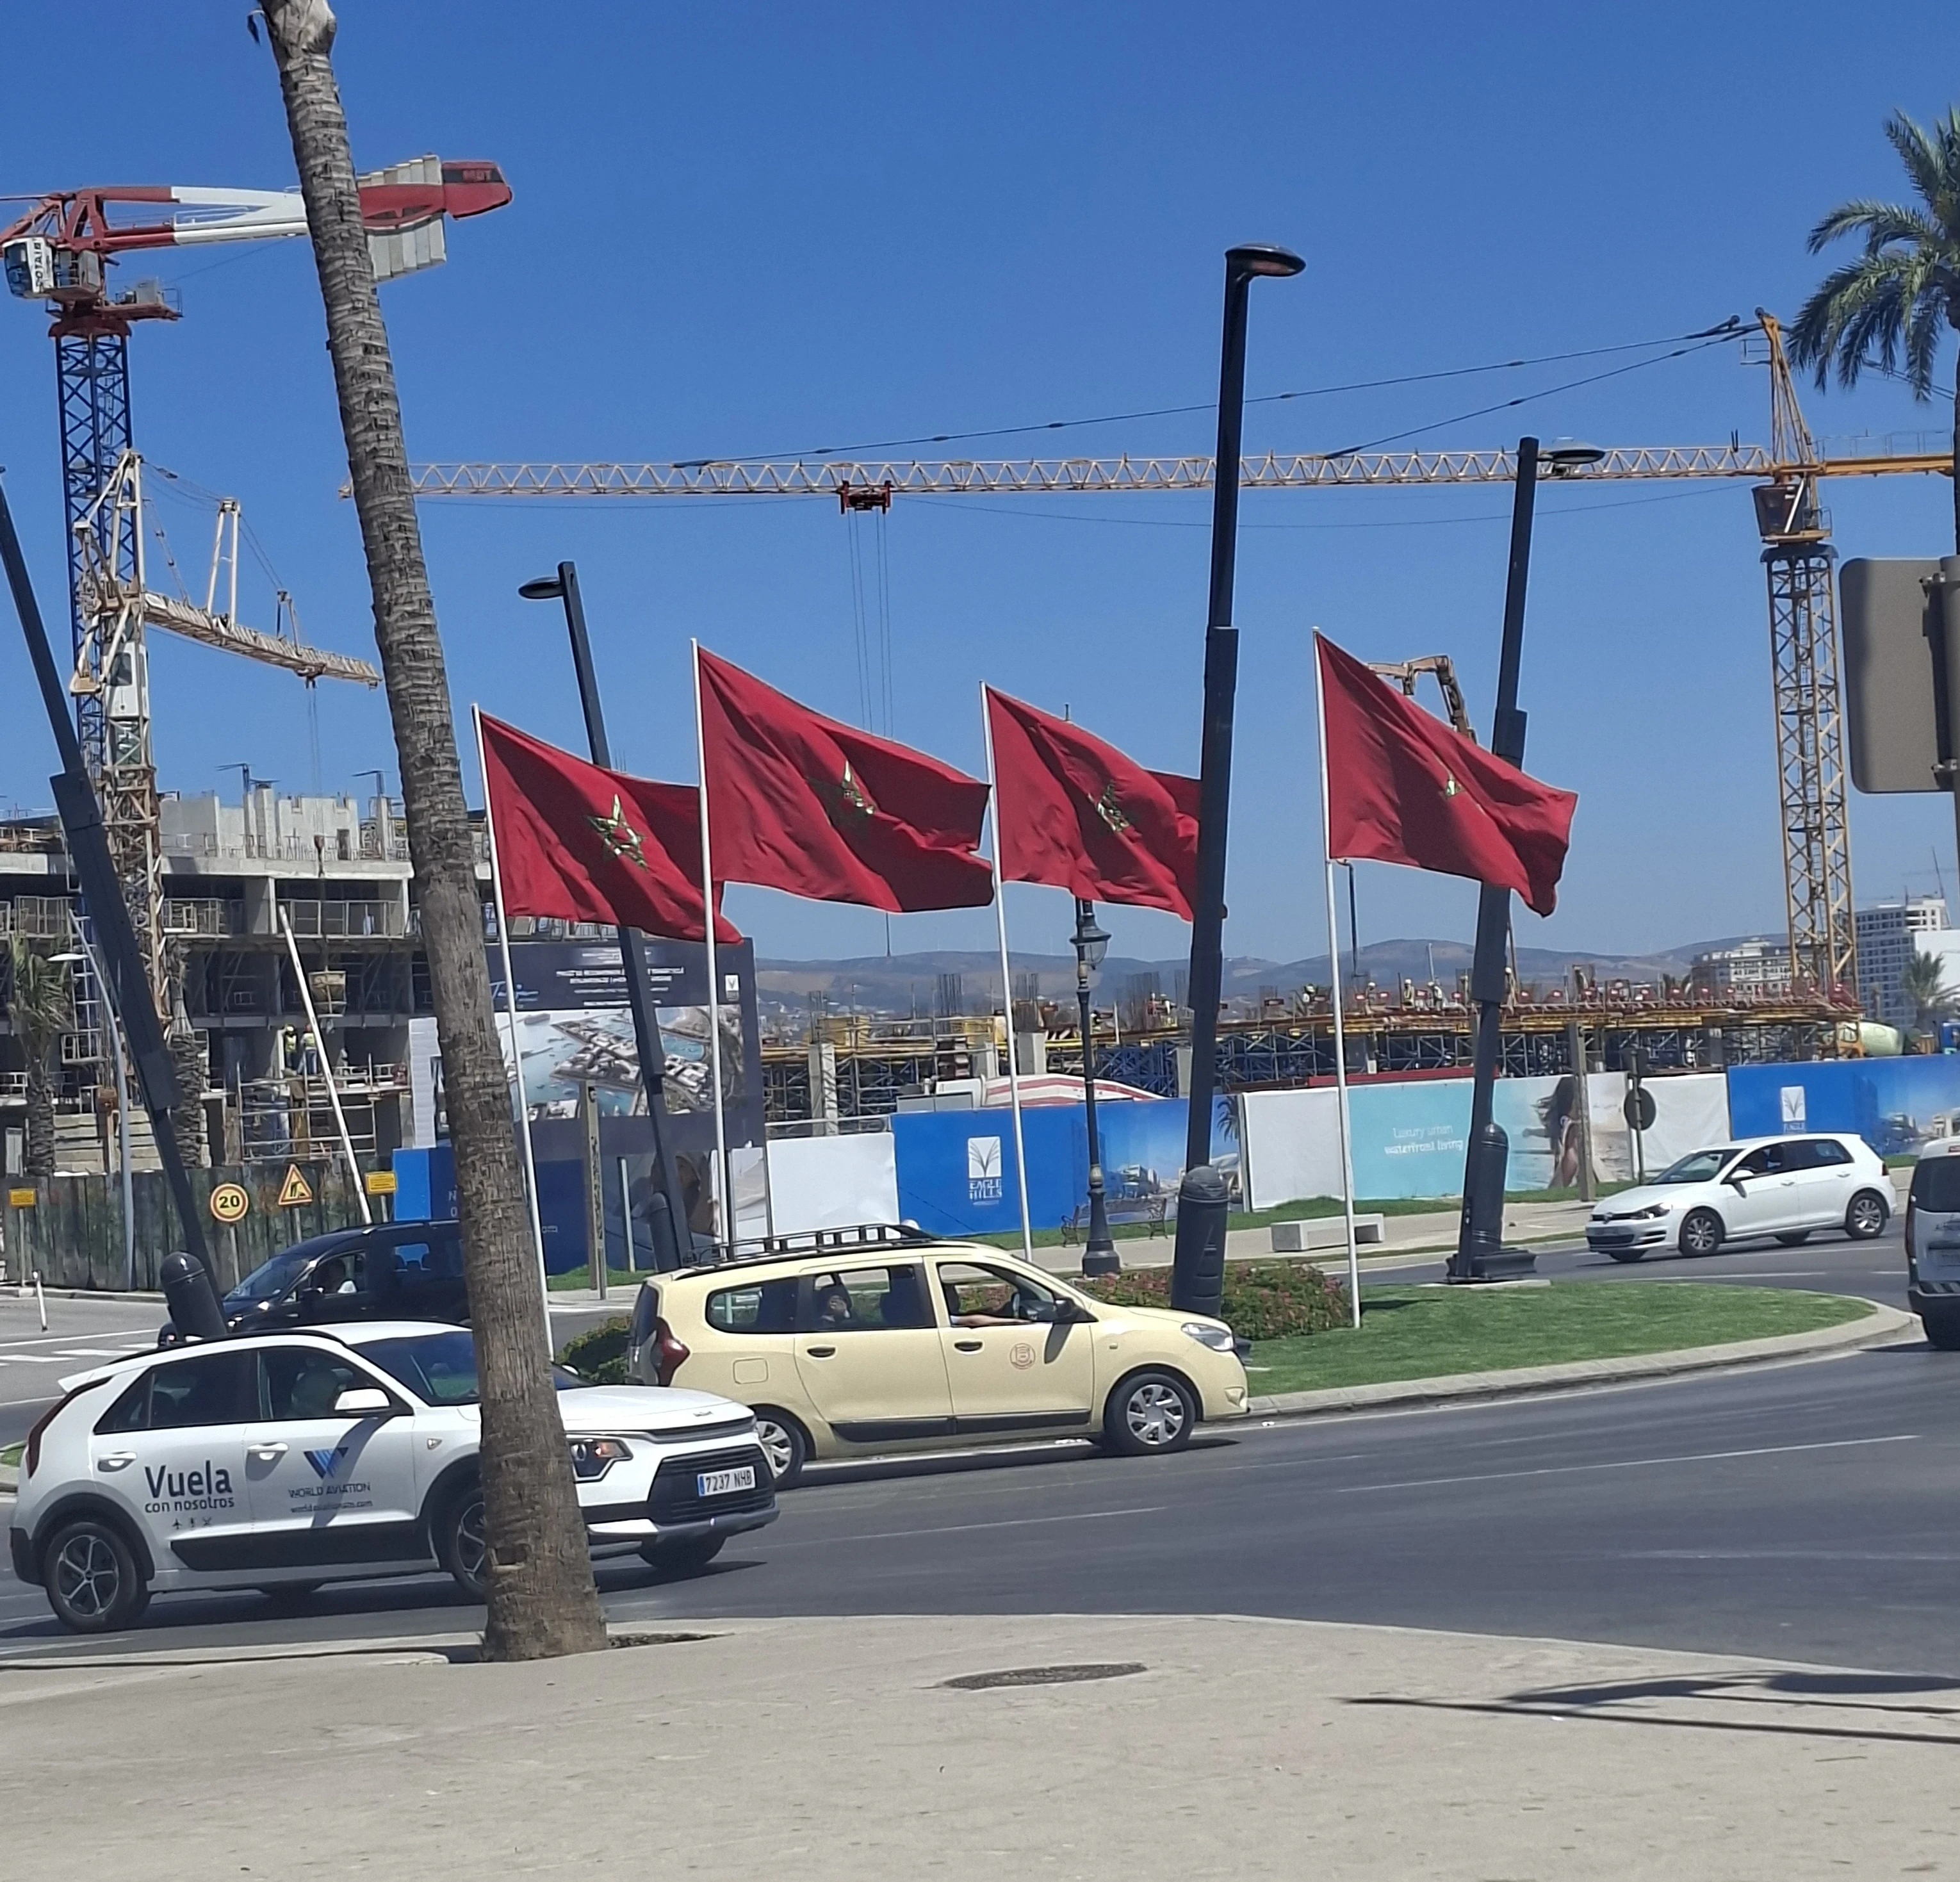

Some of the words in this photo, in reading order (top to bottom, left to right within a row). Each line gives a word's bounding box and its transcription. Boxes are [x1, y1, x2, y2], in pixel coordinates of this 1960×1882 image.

[968, 1179, 1001, 1190] EAGLE
[218, 1195, 240, 1209] 20
[968, 1190, 1002, 1200] HILLS
[145, 1459, 233, 1498] Vuela
[706, 1473, 731, 1493] 7237
[288, 1485, 323, 1499] WORLD
[325, 1483, 372, 1495] AVIATION
[144, 1502, 170, 1513] con
[174, 1496, 235, 1512] nosotros
